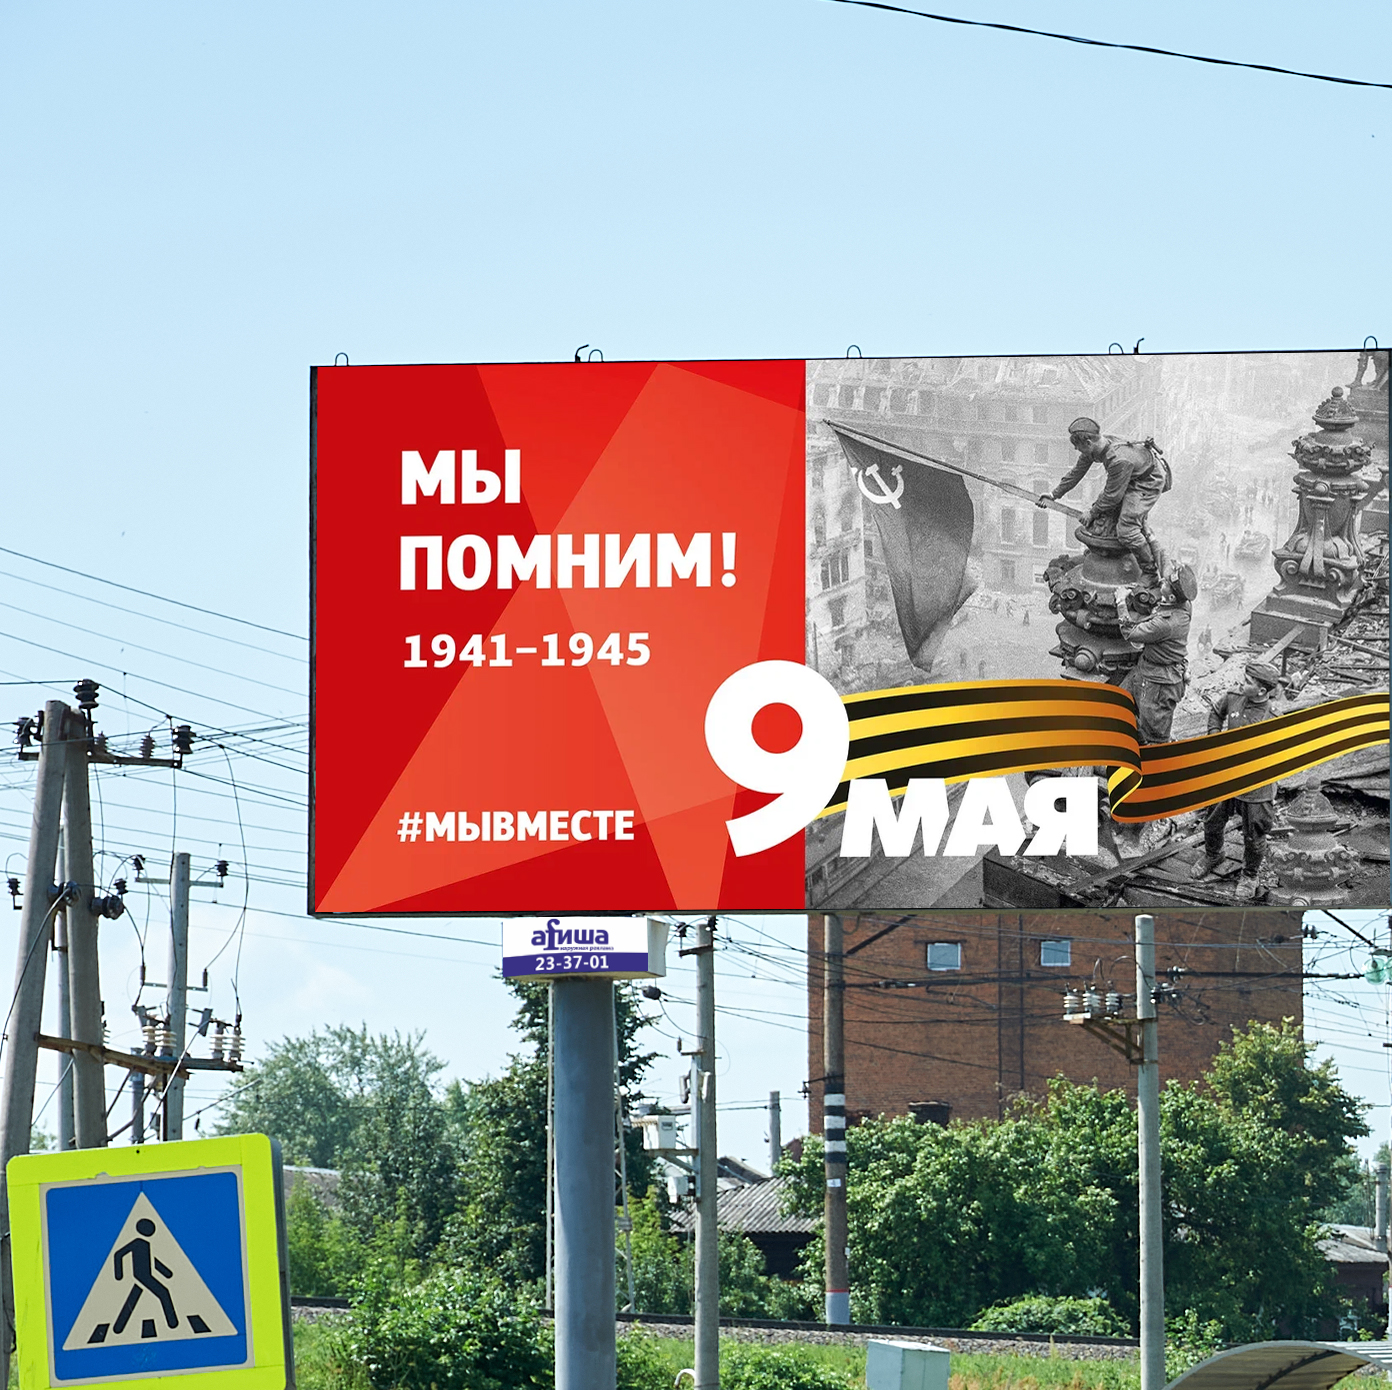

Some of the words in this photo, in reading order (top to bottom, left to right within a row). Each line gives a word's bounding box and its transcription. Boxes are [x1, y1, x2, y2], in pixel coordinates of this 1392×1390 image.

[400, 448, 522, 506] МЫ
[399, 531, 738, 592] ПОМНИМ!
[704, 659, 850, 858] 9
[838, 776, 1099, 858] МАЯ
[396, 809, 635, 844] #МЫВМЕСТЕ
[535, 955, 609, 971] 23-37-01
